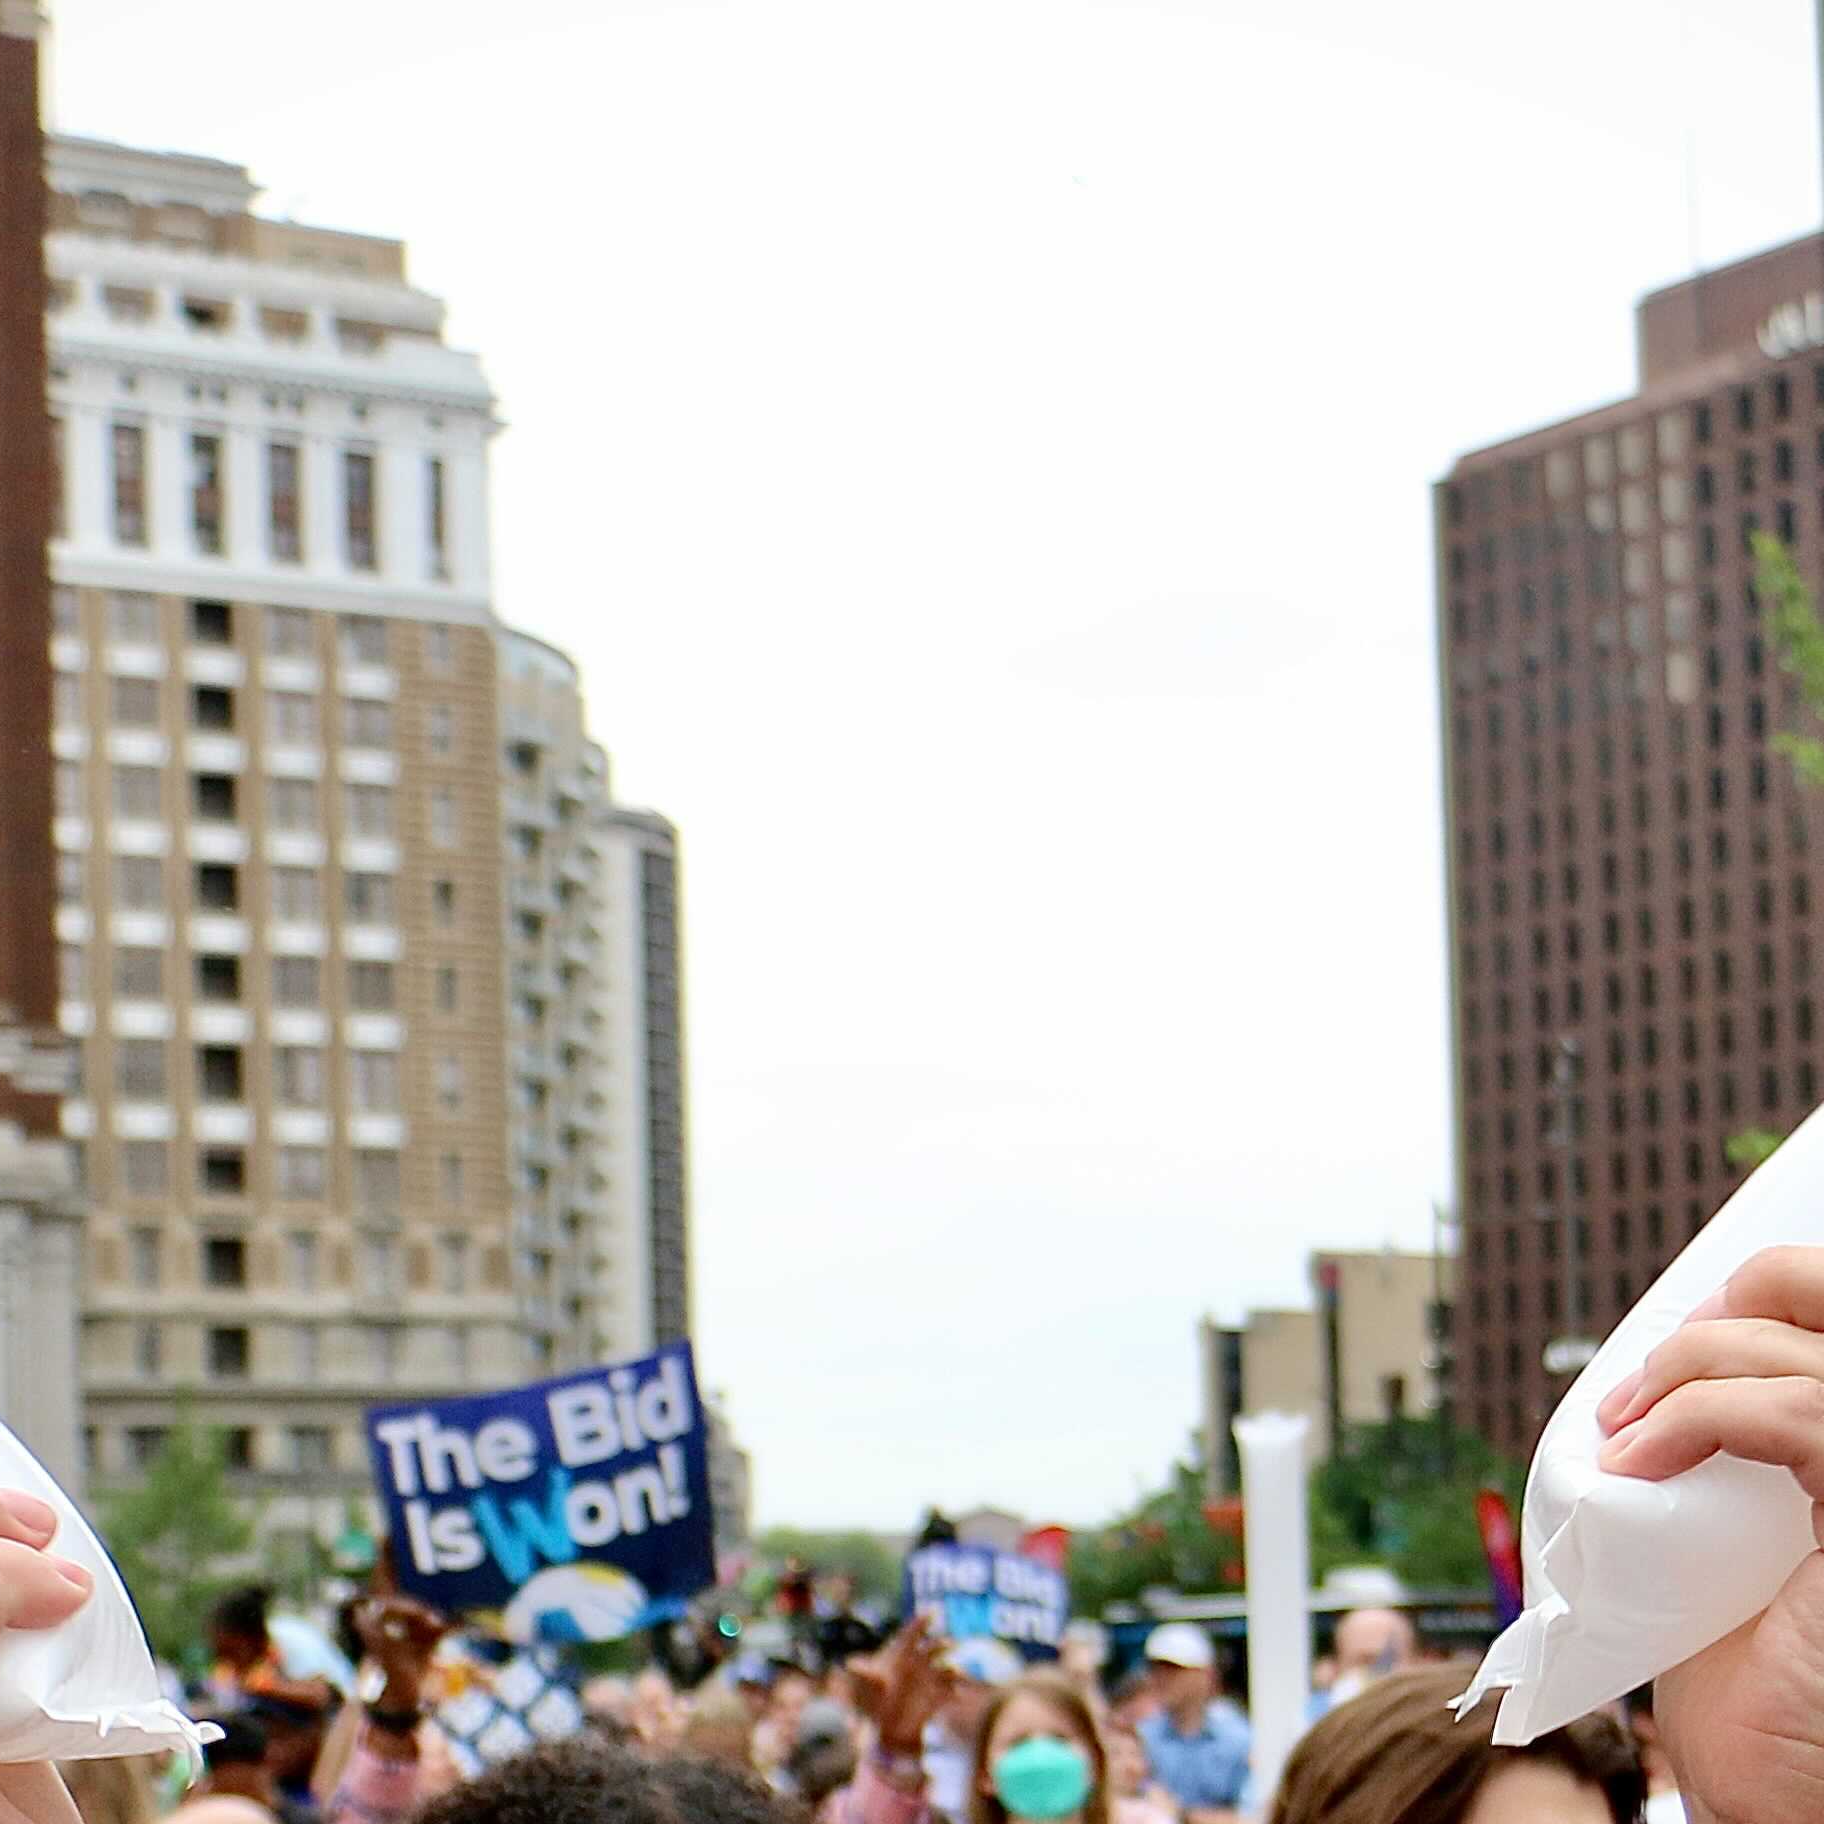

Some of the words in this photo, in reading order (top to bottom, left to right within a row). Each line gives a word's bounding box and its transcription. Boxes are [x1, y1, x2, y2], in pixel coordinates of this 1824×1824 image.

[377, 1412, 538, 1497] The
[548, 1355, 693, 1469] Bid
[405, 1501, 486, 1576] Is
[475, 1445, 692, 1585] Won!
